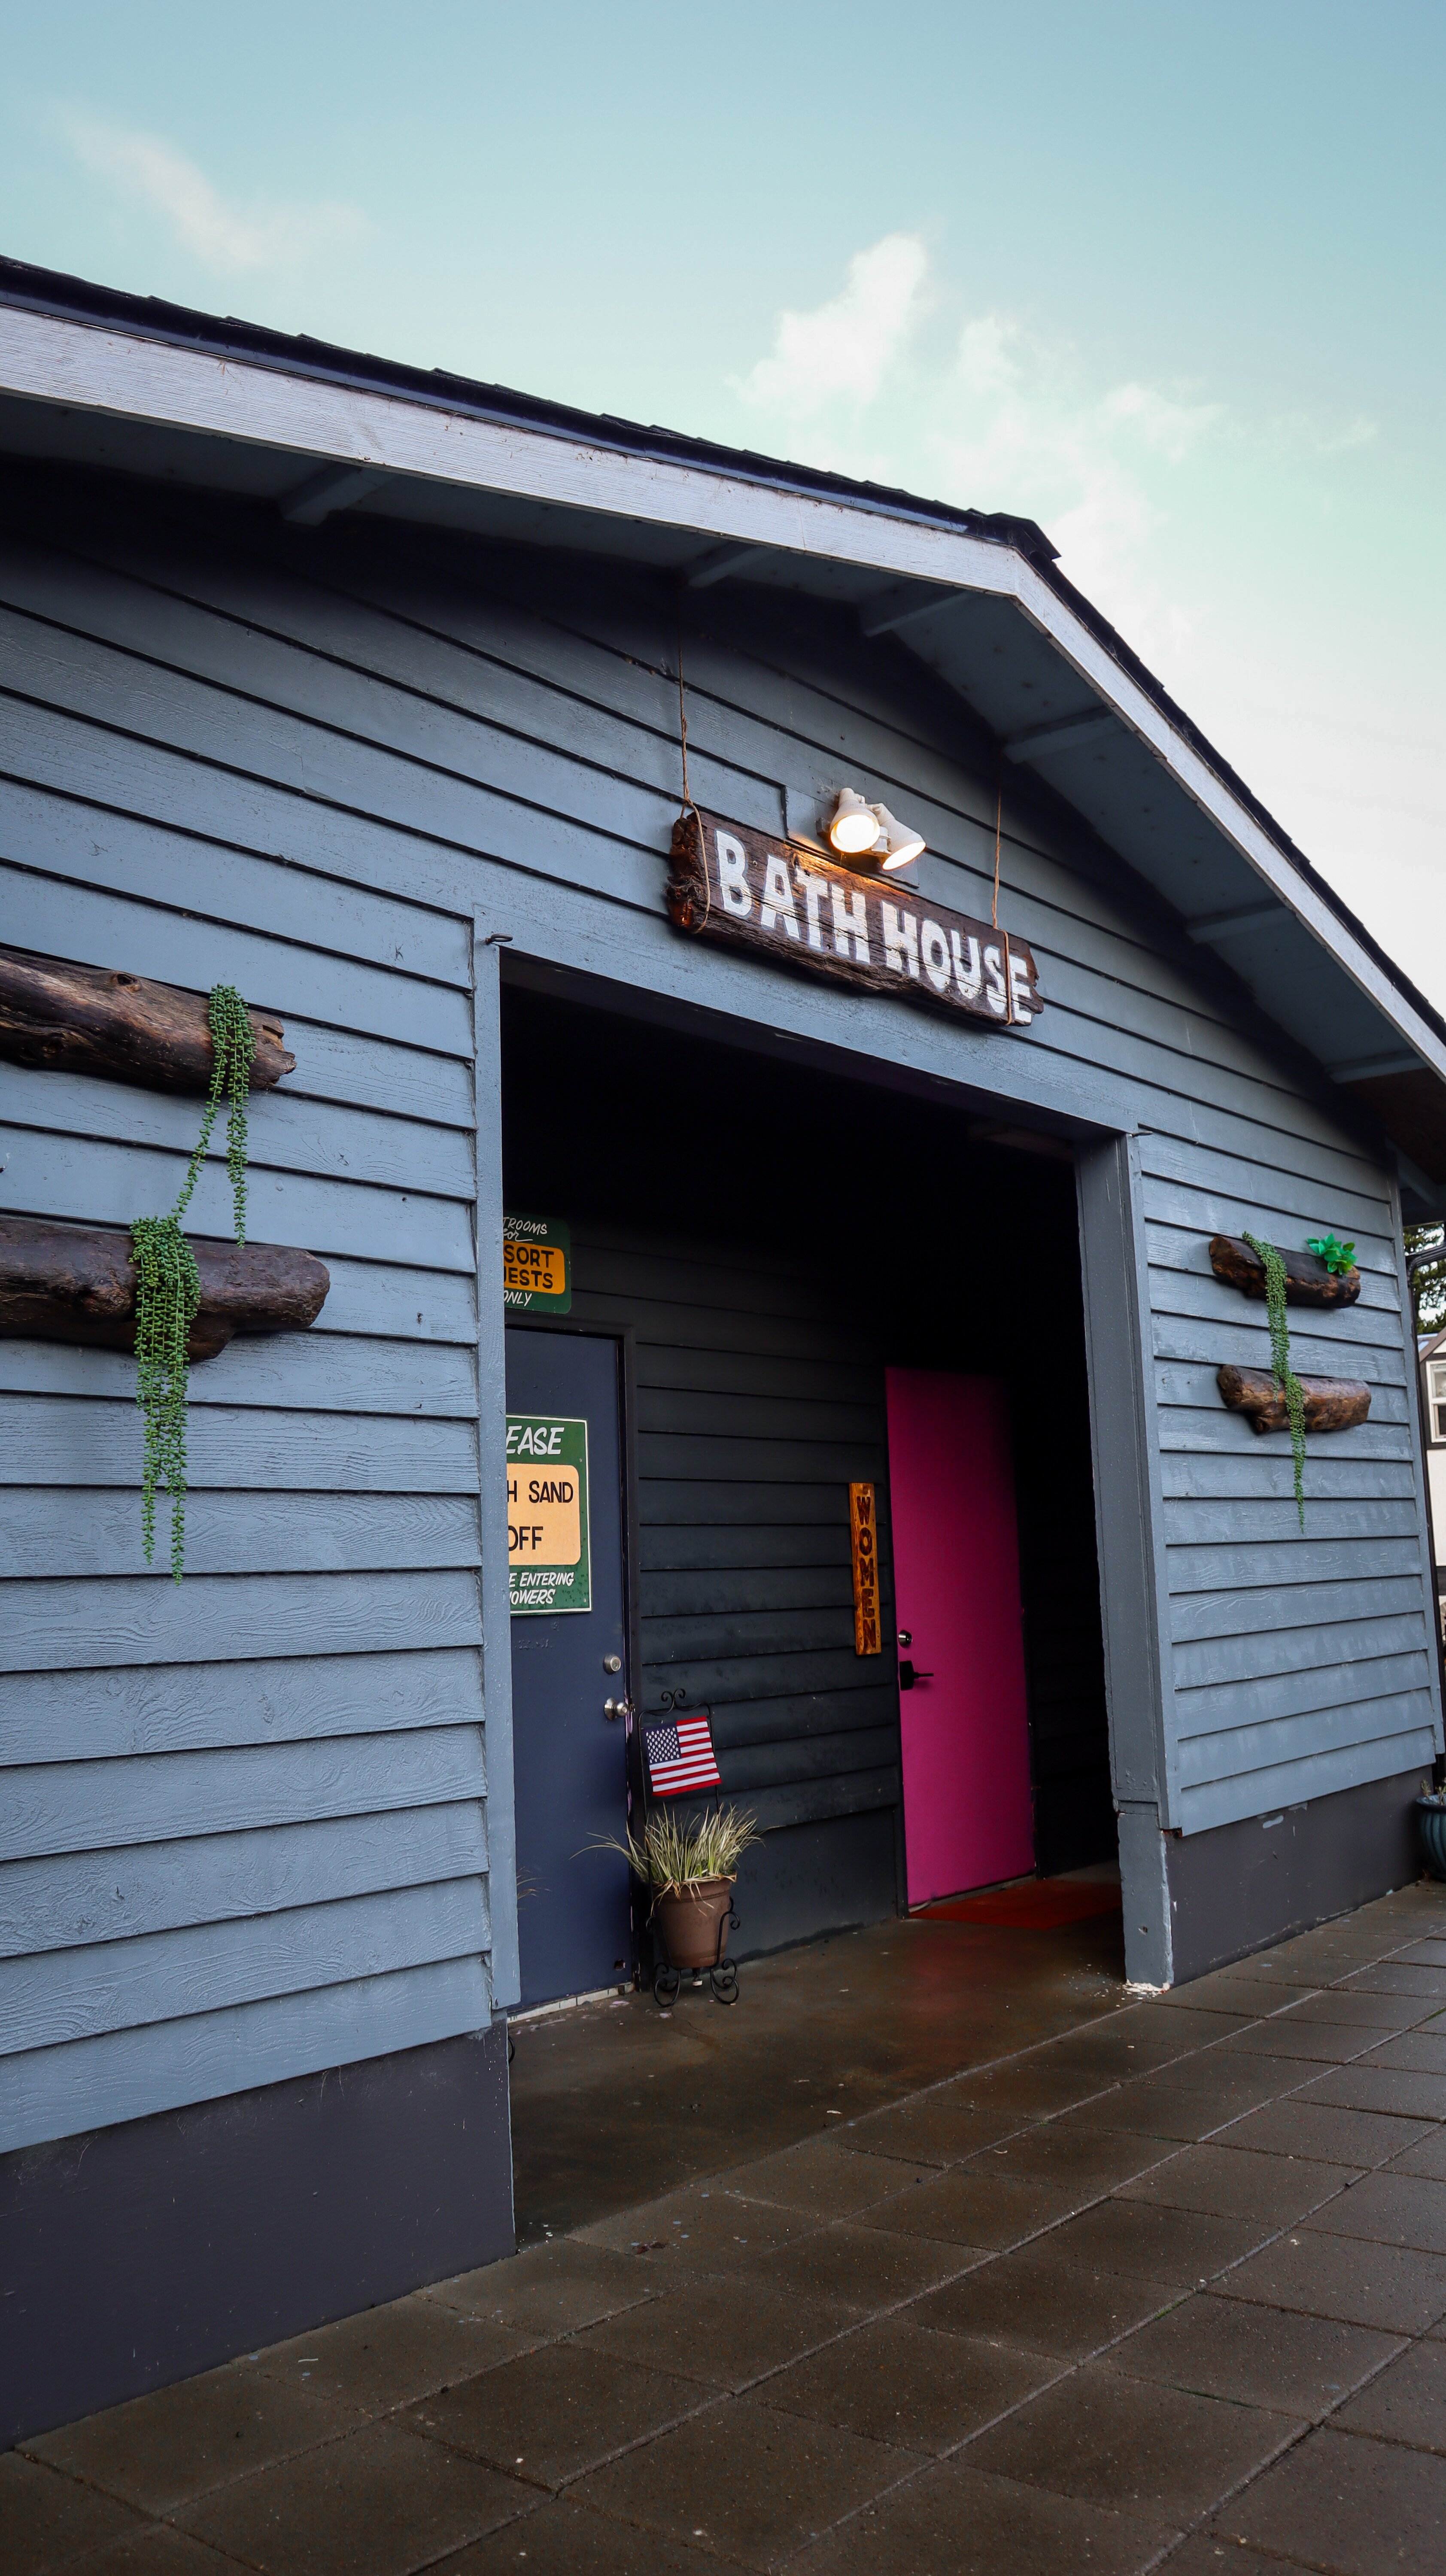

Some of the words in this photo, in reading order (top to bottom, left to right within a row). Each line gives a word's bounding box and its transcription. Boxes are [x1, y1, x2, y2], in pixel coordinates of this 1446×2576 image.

[715, 828, 871, 964] BATH
[881, 900, 1032, 1023] HOUSE
[503, 1216, 547, 1235] TROOMS
[503, 1228, 533, 1242] or
[504, 1244, 554, 1268] SORT
[504, 1266, 553, 1289] ESTS
[506, 1425, 565, 1455] EASE
[529, 1480, 574, 1503] SAND
[508, 1525, 544, 1552] OFF
[519, 1572, 574, 1587] ENTERING
[857, 1496, 876, 1653] WOMEN
[510, 1589, 556, 1605] OWERS
